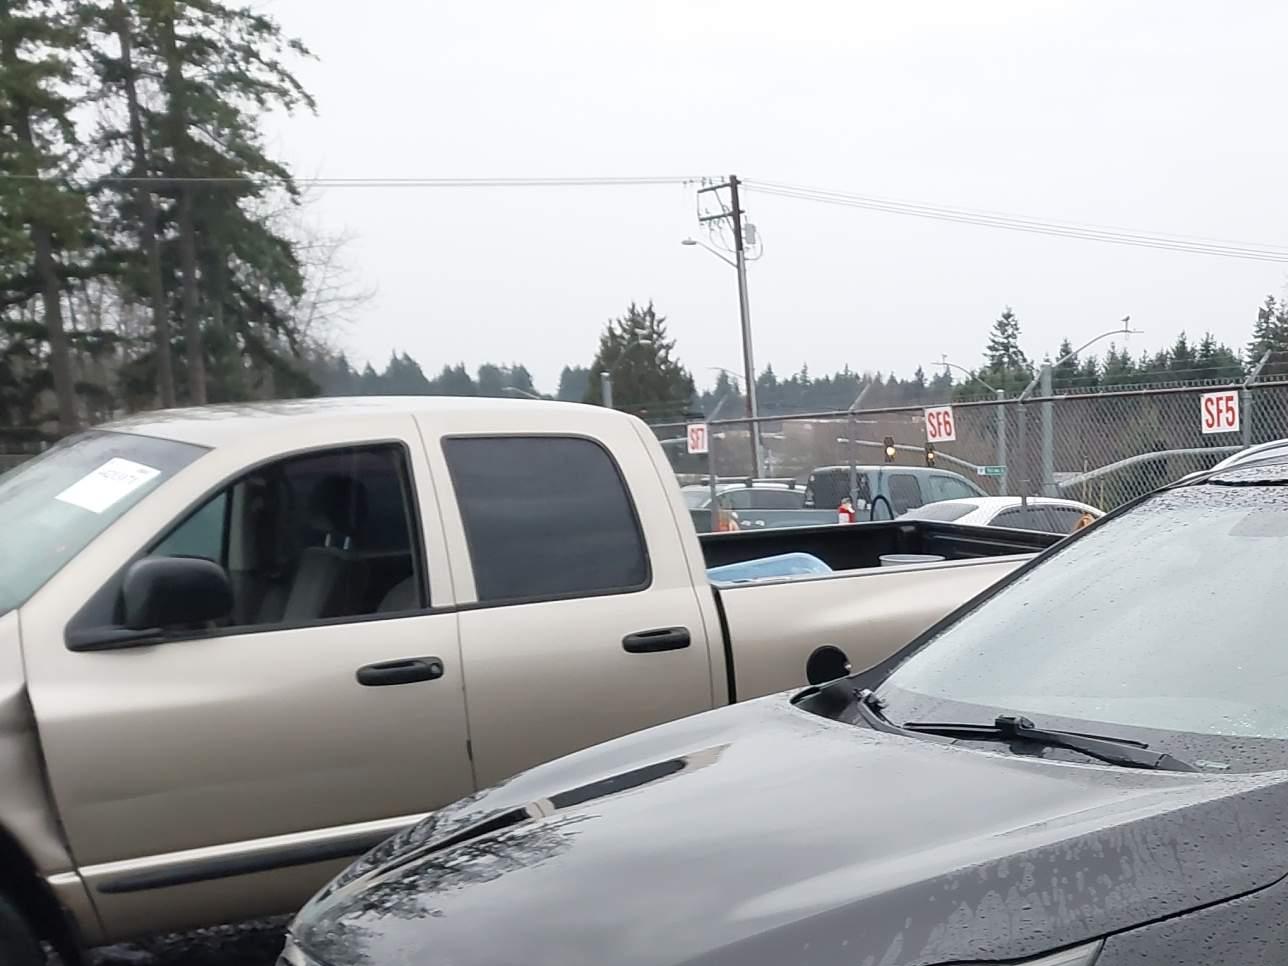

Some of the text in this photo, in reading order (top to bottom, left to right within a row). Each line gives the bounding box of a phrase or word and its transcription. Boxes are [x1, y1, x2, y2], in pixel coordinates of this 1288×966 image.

[927, 410, 953, 438] SF6
[1204, 395, 1236, 429] SF5
[690, 427, 705, 450] SF7
